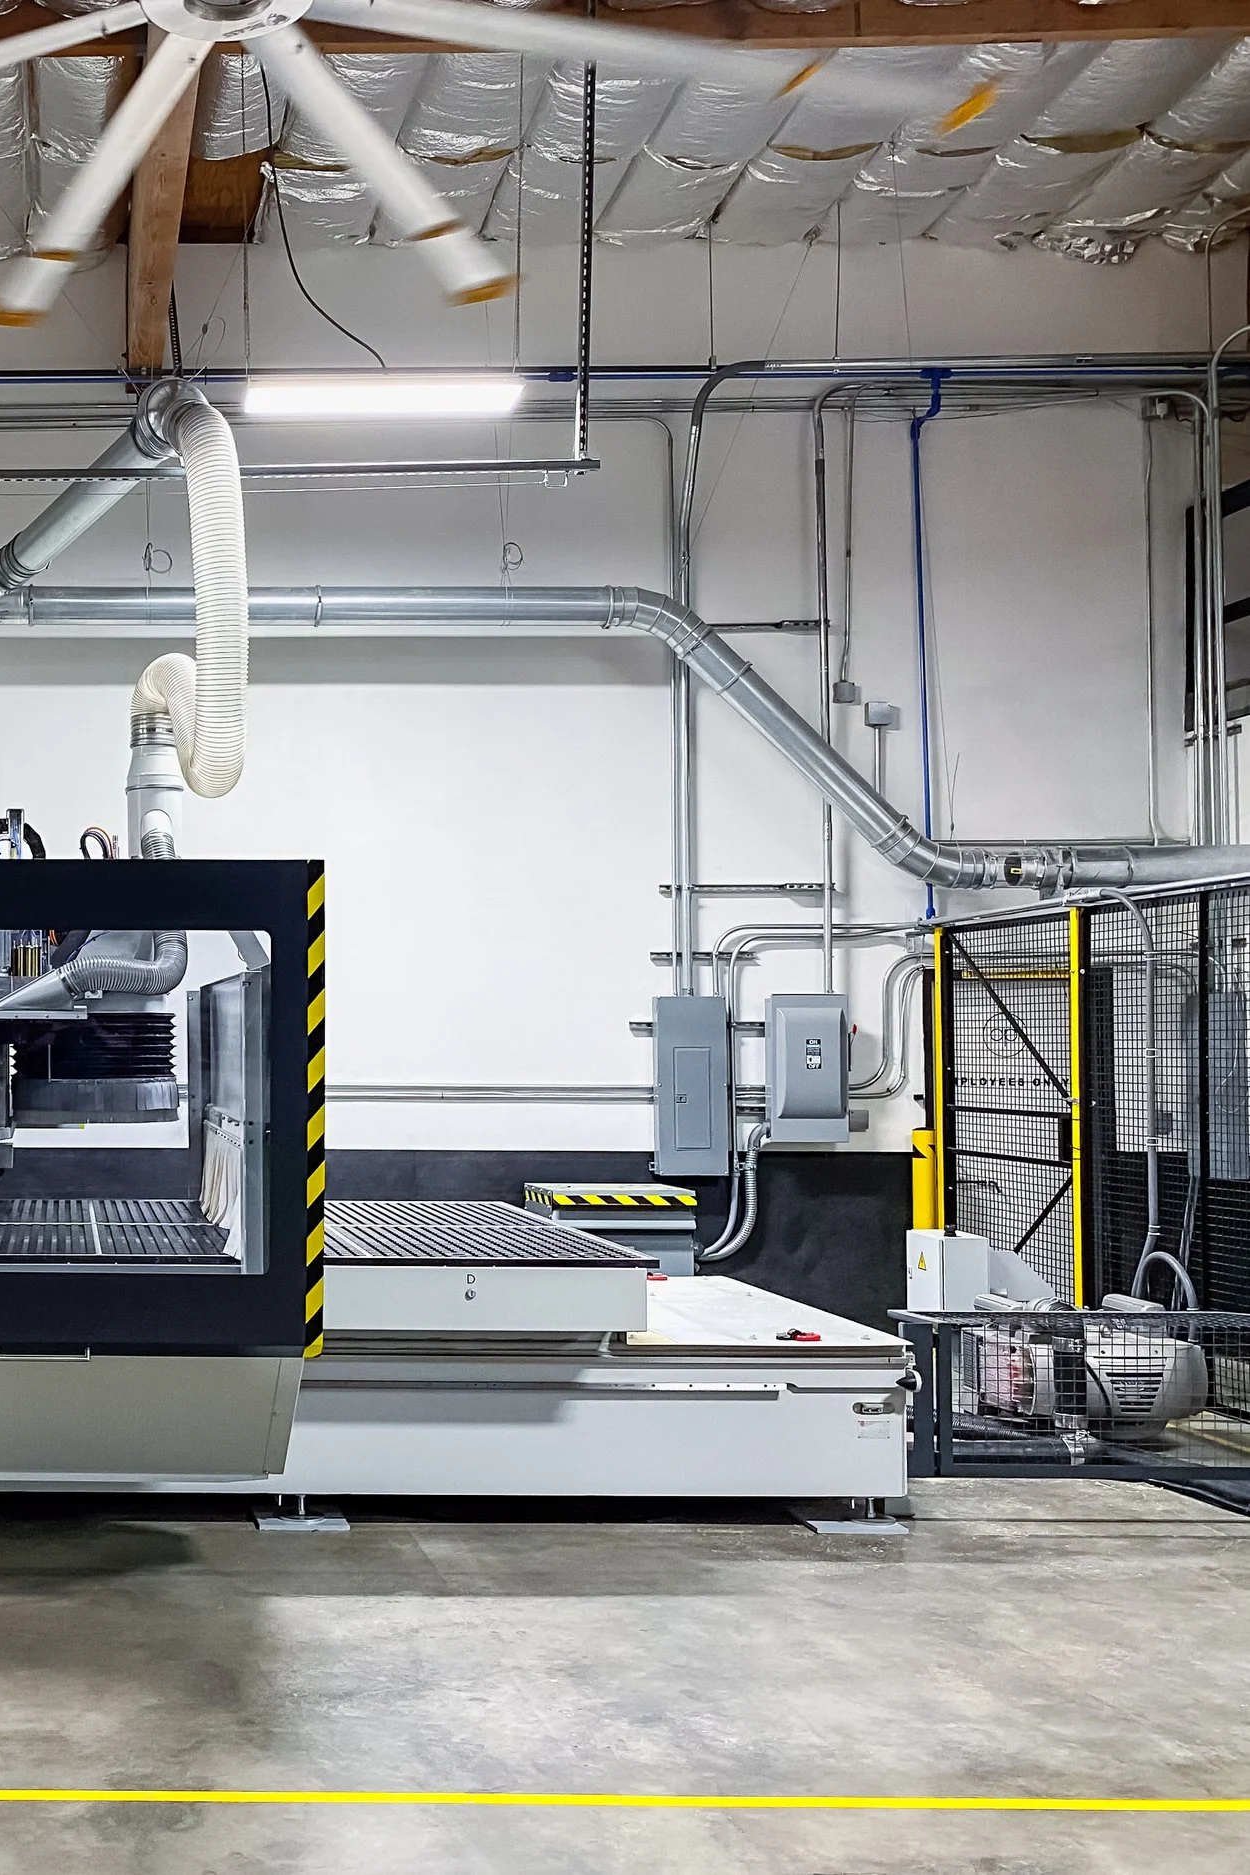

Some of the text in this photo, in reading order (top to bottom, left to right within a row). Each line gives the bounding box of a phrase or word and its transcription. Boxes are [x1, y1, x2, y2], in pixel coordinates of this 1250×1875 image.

[954, 1077, 1070, 1088] PLOYEES ONY
[466, 1273, 476, 1285] D
